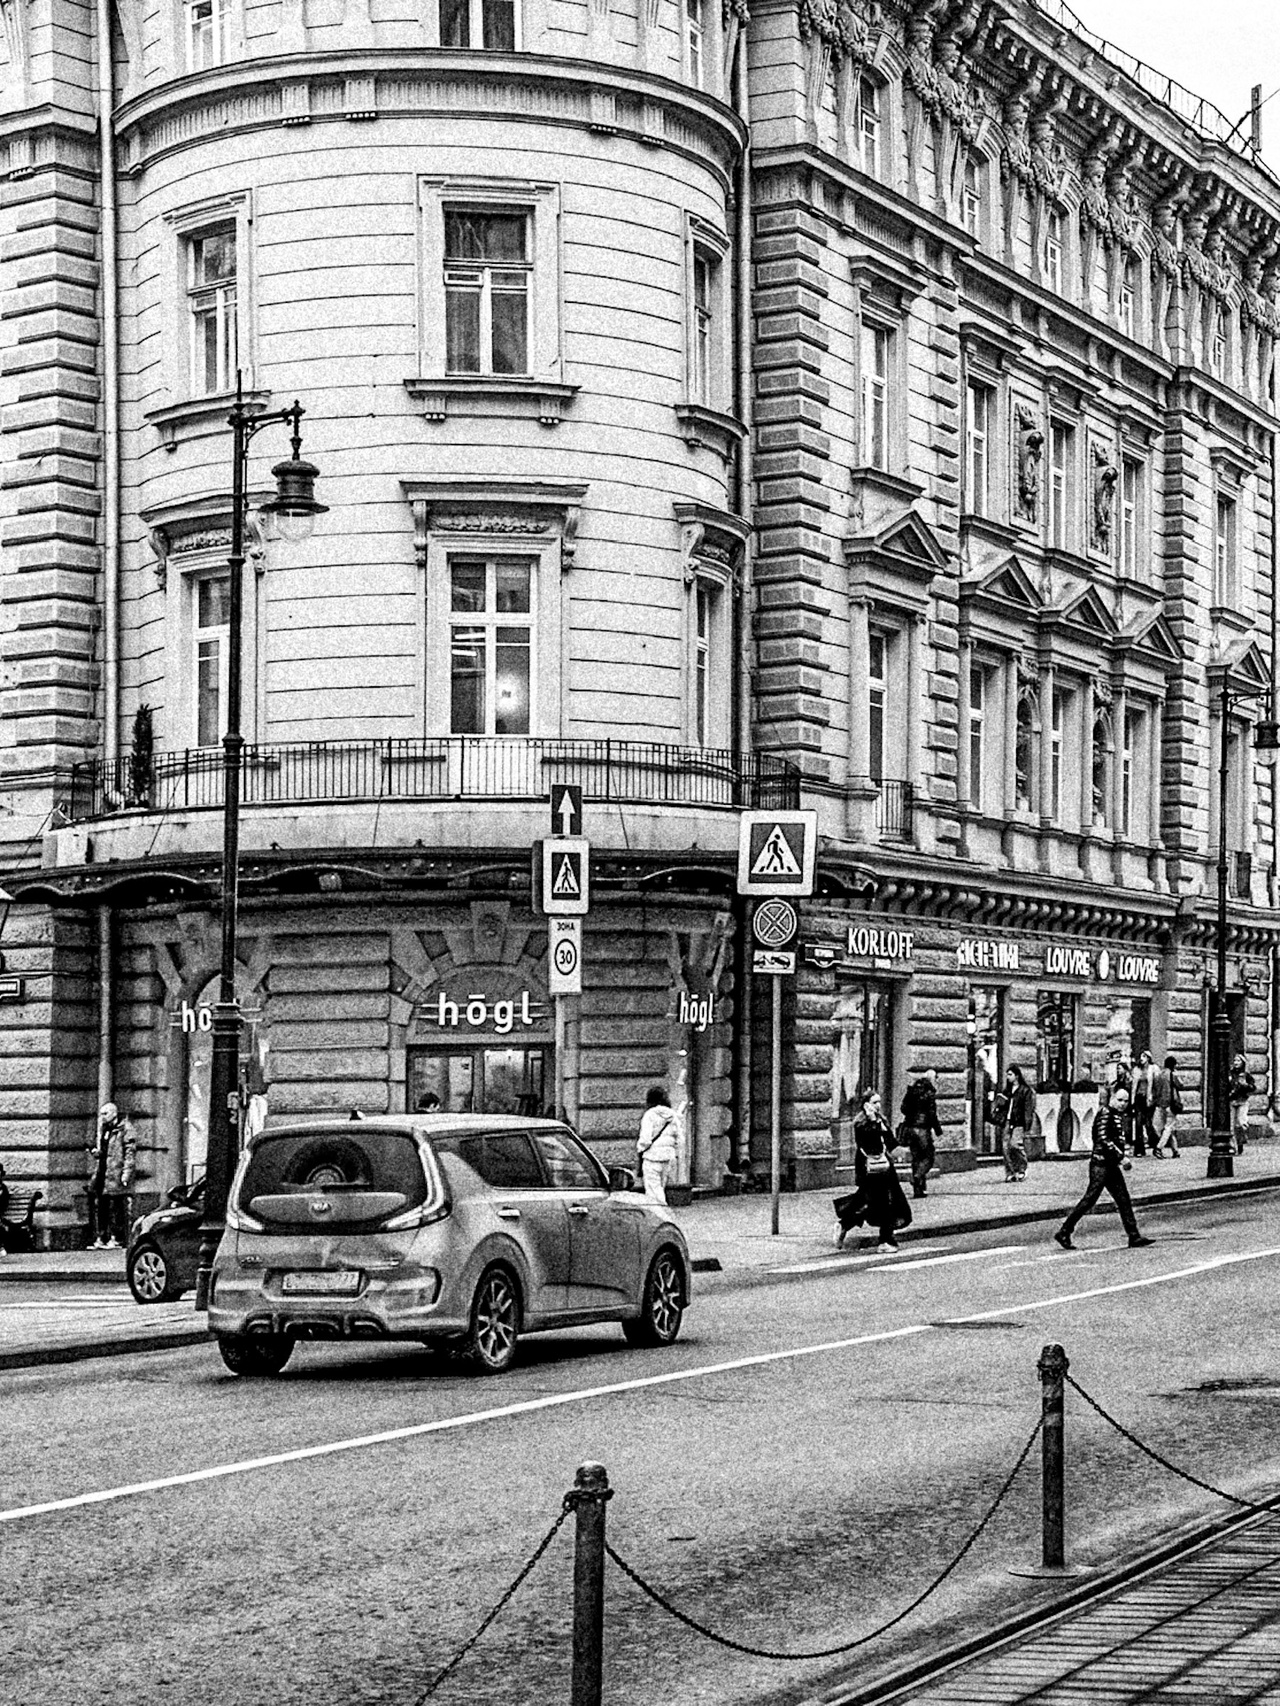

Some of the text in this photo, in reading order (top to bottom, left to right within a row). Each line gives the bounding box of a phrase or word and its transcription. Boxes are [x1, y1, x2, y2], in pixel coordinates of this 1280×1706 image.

[559, 949, 573, 965] 30
[848, 927, 915, 958] KORLOFF
[1046, 946, 1091, 976] LOUVRE
[1118, 954, 1159, 983] LOUVRE
